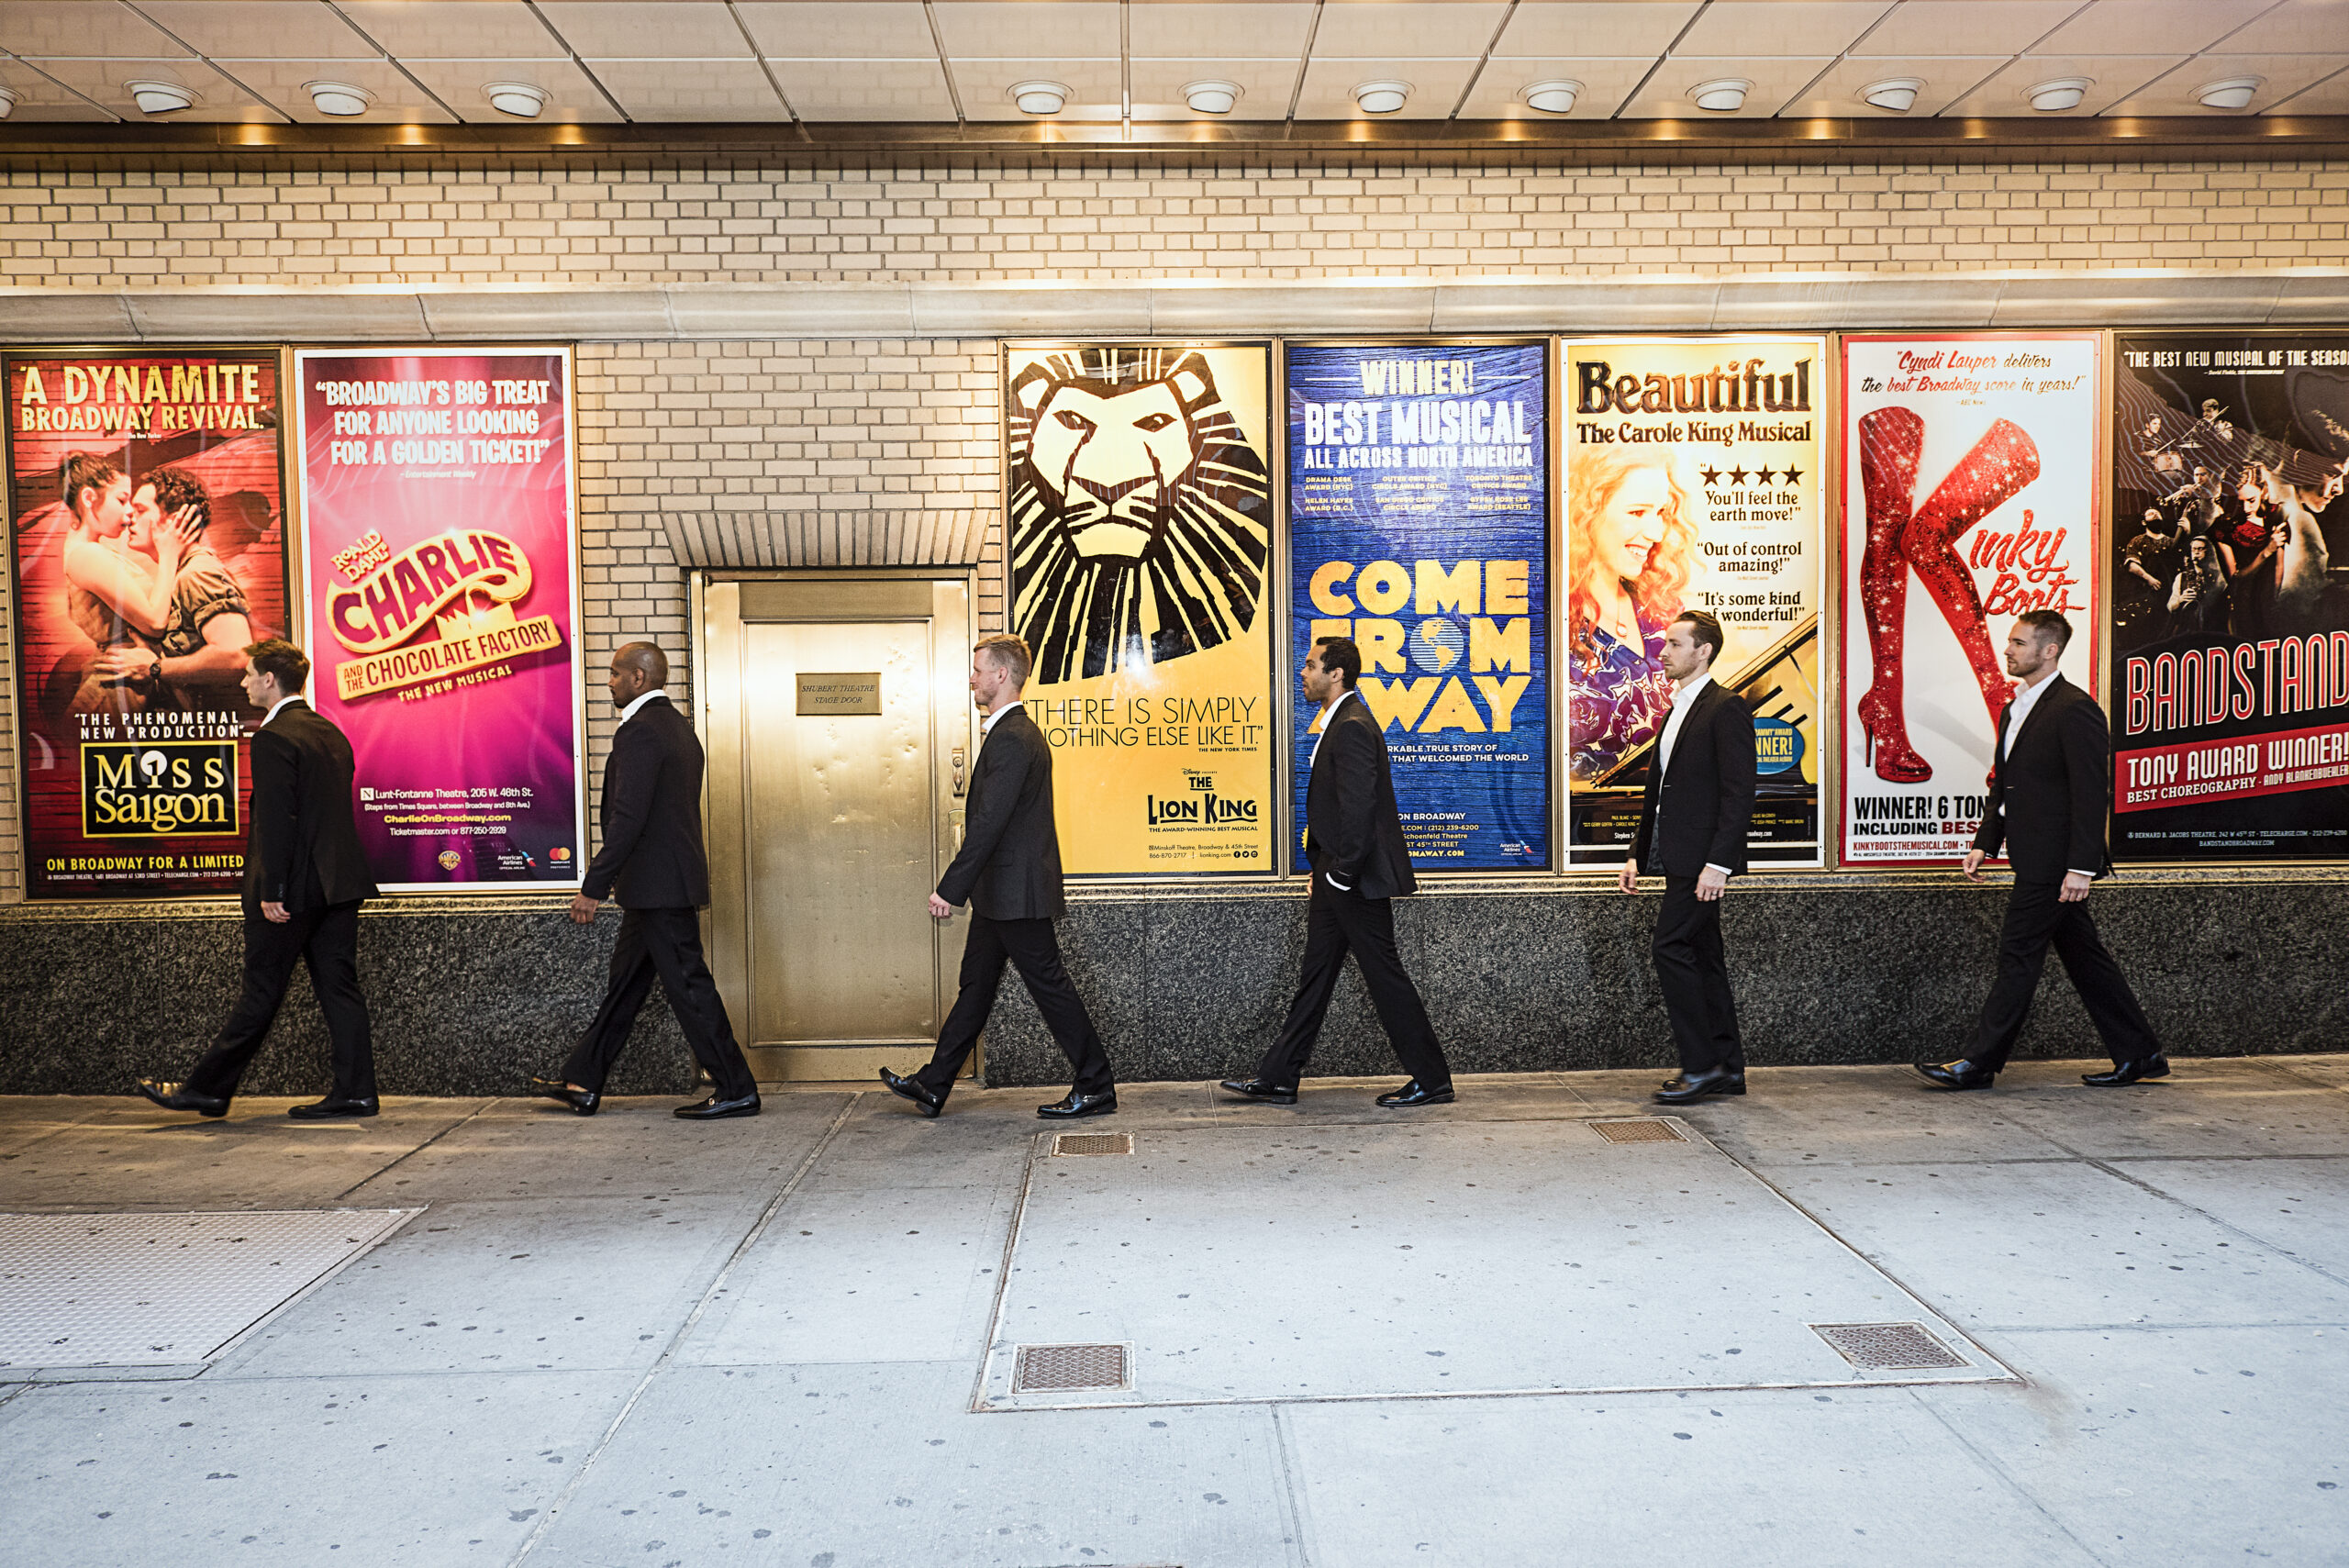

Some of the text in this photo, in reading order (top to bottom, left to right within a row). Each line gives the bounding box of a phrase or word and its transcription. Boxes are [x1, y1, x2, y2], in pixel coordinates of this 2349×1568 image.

[1947, 350, 1997, 373] Lauper
[2004, 353, 2051, 368] delivers
[2154, 351, 2181, 367] BEST
[2186, 351, 2210, 366] NEW
[2215, 350, 2265, 366] MUSICAL
[2268, 350, 2283, 366] OF
[2286, 350, 2308, 365] THE
[2310, 350, 2349, 365] SEASO
[64, 364, 260, 404] DYNAMITE
[1360, 360, 1474, 395] WINNER!
[1576, 357, 1812, 415] Beautiful
[1862, 376, 1882, 393] the
[1887, 376, 1917, 392] best
[1917, 376, 1982, 395] Broadway
[1985, 381, 2016, 392] score
[2021, 376, 2033, 392] in
[455, 381, 487, 405] BIG
[492, 380, 550, 404] TREAT
[21, 406, 154, 431] BROADWAY
[334, 410, 539, 435] FOR ANYONE LOOKING
[1304, 400, 1531, 446] BEST MUSICAL
[1576, 420, 1812, 447] The Carole King Musical
[331, 440, 368, 465] FOR
[373, 440, 386, 465] A
[392, 439, 466, 464] GOLDEN
[1304, 446, 1533, 469] ALL ACROSS NORTH AMERICA
[1705, 491, 1798, 506] You'll feel the
[1709, 508, 1747, 521] earth
[330, 530, 382, 571] ROALD
[1732, 541, 1748, 556] of
[1751, 541, 1802, 555] control
[333, 534, 518, 642] CHARLIE
[1309, 560, 1529, 616] COME
[1729, 595, 1765, 606] some
[1769, 591, 1801, 606] kind
[1984, 573, 2086, 616] Boots
[367, 620, 551, 686] CHOCOLATE FACTORY
[344, 665, 363, 680] AND
[397, 664, 513, 703] THE NEW MUSICAL
[2126, 630, 2349, 735] BANDSTAND
[346, 680, 364, 692] THE
[801, 684, 838, 693] SHUBERT
[121, 711, 239, 725] PHENOMENAL
[1128, 697, 1151, 724] IS
[1163, 696, 1257, 724] SIMPLY
[80, 727, 116, 740] NEW
[1147, 726, 1189, 746] ELSE
[1197, 726, 1233, 745] LIKE
[94, 751, 225, 789] Miss
[1419, 754, 1473, 762] WELCOMED
[2126, 731, 2349, 787] TONY AWARD WINNER!
[375, 789, 433, 799] Lunt-Fontanne
[436, 789, 469, 799] Theatre,
[471, 788, 487, 798] 205
[488, 788, 498, 797] W.
[500, 787, 520, 797] 46th
[1188, 776, 1212, 788] THE
[2127, 790, 2157, 803] BEST
[2161, 777, 2256, 799] CHOREOGRAPHY
[2264, 773, 2284, 786] ANDY
[95, 788, 228, 832] Saigon
[384, 814, 512, 824] CharlieOnBroadway.com
[1854, 796, 1932, 820] WINNER!
[1938, 795, 1948, 819] 6
[390, 827, 450, 836] Ticketmaster.com
[1854, 821, 1982, 836] INCLUDING BES
[1854, 840, 1958, 851] KINKYBOOTSTHEMUSICAL.COM
[47, 855, 244, 871] ON BROADWAY FOR A LIMITED
